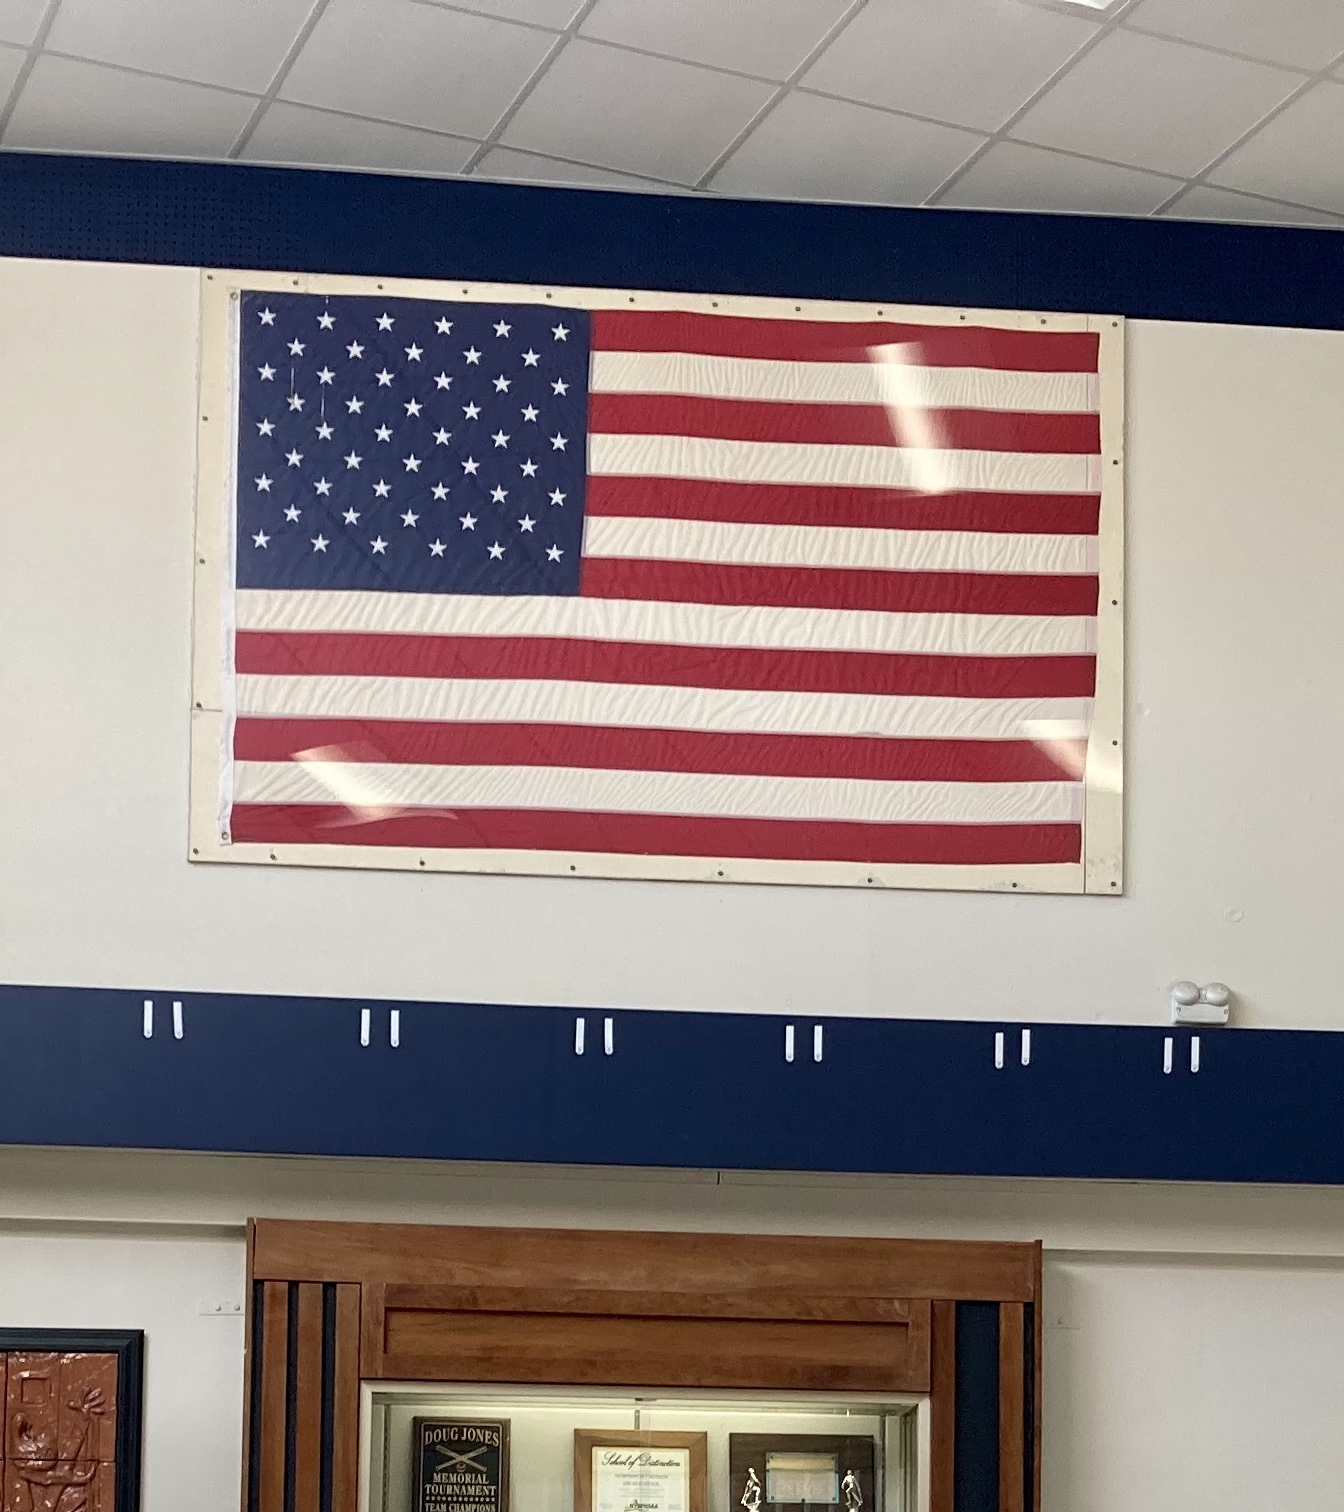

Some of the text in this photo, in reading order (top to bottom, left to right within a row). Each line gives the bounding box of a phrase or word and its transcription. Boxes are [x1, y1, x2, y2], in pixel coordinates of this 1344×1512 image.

[424, 1427, 499, 1447] DOUG JONES
[433, 1472, 489, 1484] MEMORIAL
[424, 1483, 497, 1496] TOURNAMENT
[424, 1502, 447, 1512] TEAM
